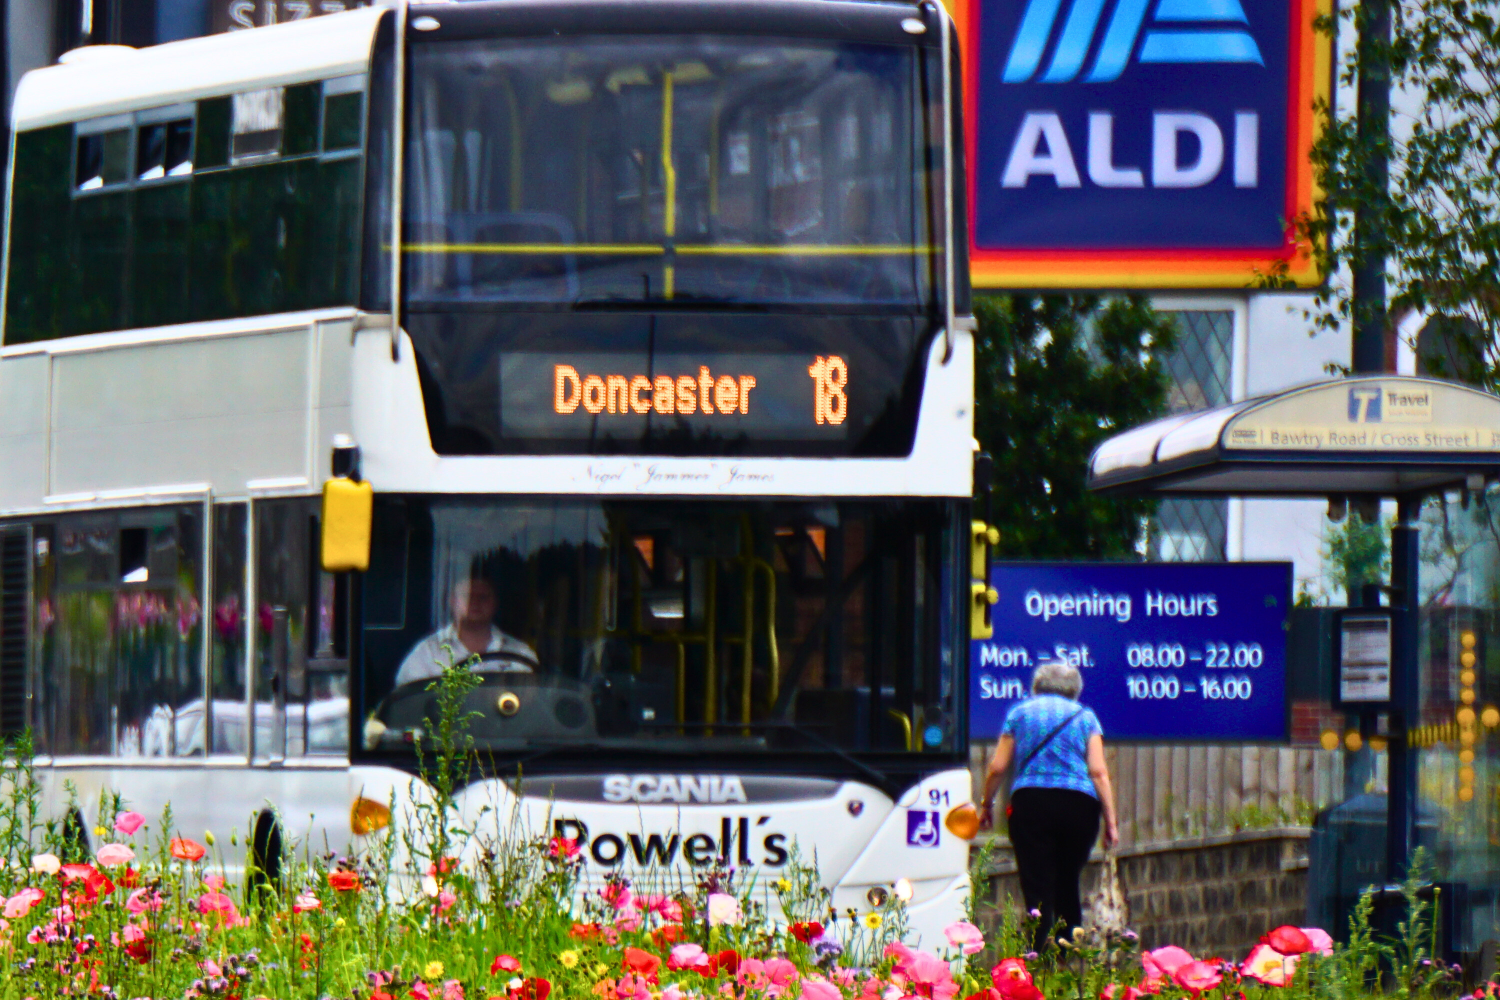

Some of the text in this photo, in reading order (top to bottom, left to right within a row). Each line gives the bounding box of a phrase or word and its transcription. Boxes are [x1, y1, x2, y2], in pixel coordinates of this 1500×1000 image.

[1000, 110, 1259, 188] ALDI
[553, 354, 849, 425] Doncaster 18
[1387, 393, 1429, 407] Travel
[1270, 430, 1323, 449] Bawtry
[1329, 431, 1367, 446] Road
[1381, 431, 1420, 447] Cross
[1425, 432, 1470, 448] Street
[718, 464, 775, 491] James
[1024, 588, 1219, 623] Opening Hours
[979, 643, 1034, 668] Mon.
[1053, 643, 1095, 668] Sat.
[1126, 642, 1186, 668] 08.00
[1204, 642, 1264, 668] 22.00
[979, 674, 1029, 700] Sun.
[1126, 675, 1181, 700] 10.00
[1200, 675, 1253, 700] 16.00
[602, 774, 748, 803] SCANIA
[928, 789, 951, 808] 91
